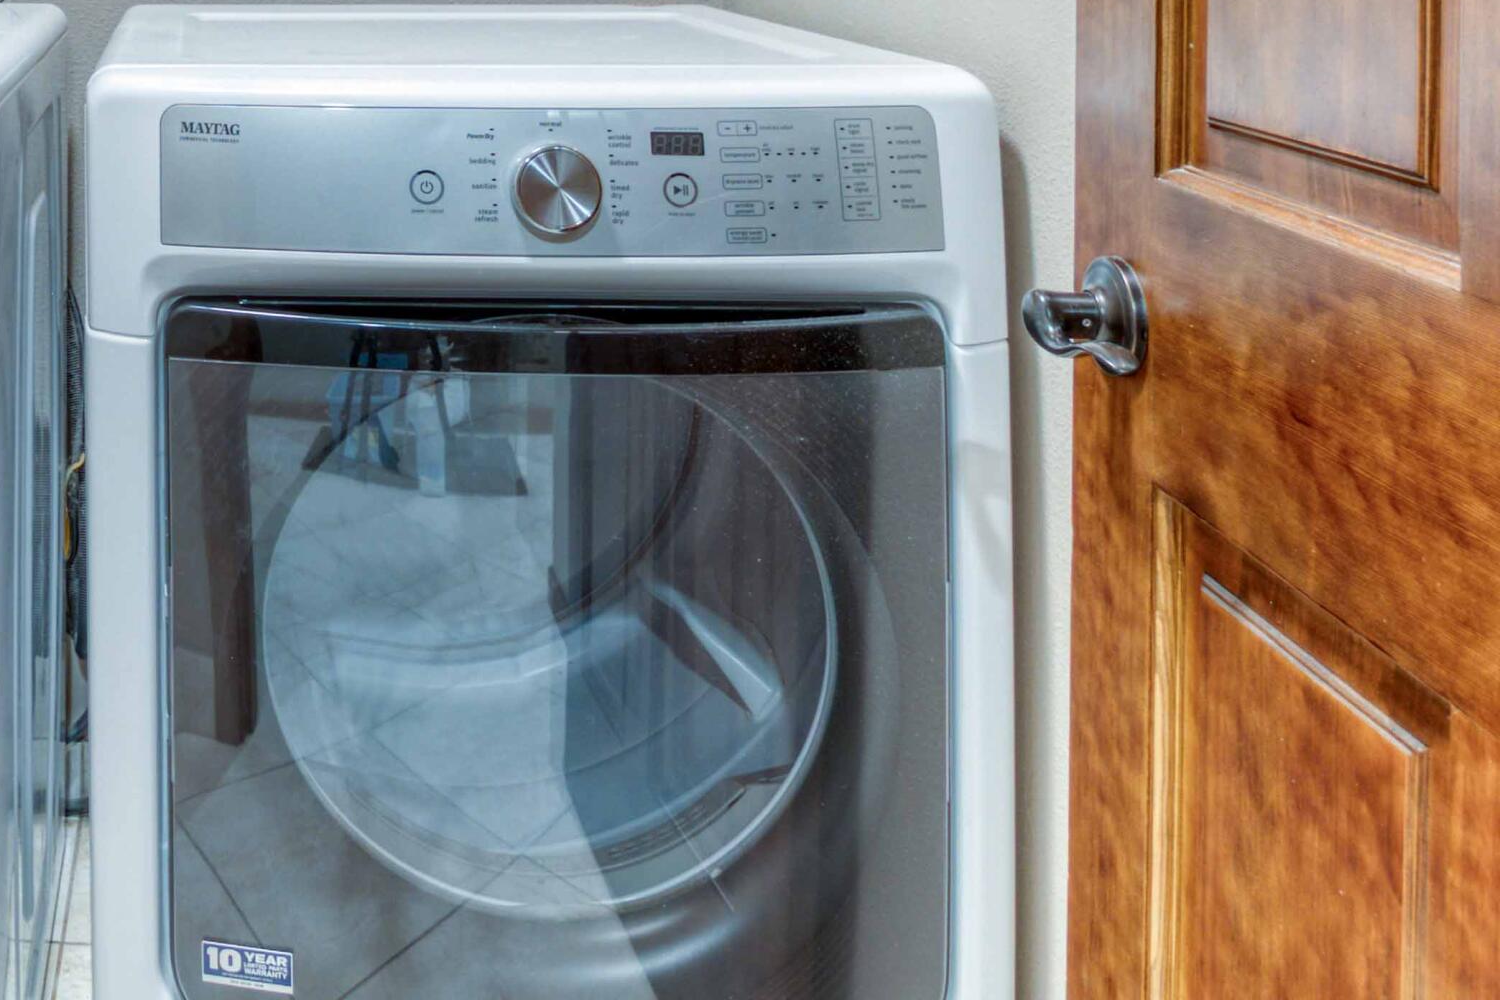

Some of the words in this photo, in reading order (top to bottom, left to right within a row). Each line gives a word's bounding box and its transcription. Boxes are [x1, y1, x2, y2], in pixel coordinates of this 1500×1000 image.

[180, 121, 240, 136] MAYTAG
[206, 946, 242, 973] 10
[244, 951, 288, 967] YEAR
[244, 968, 288, 980] WARRANTY
